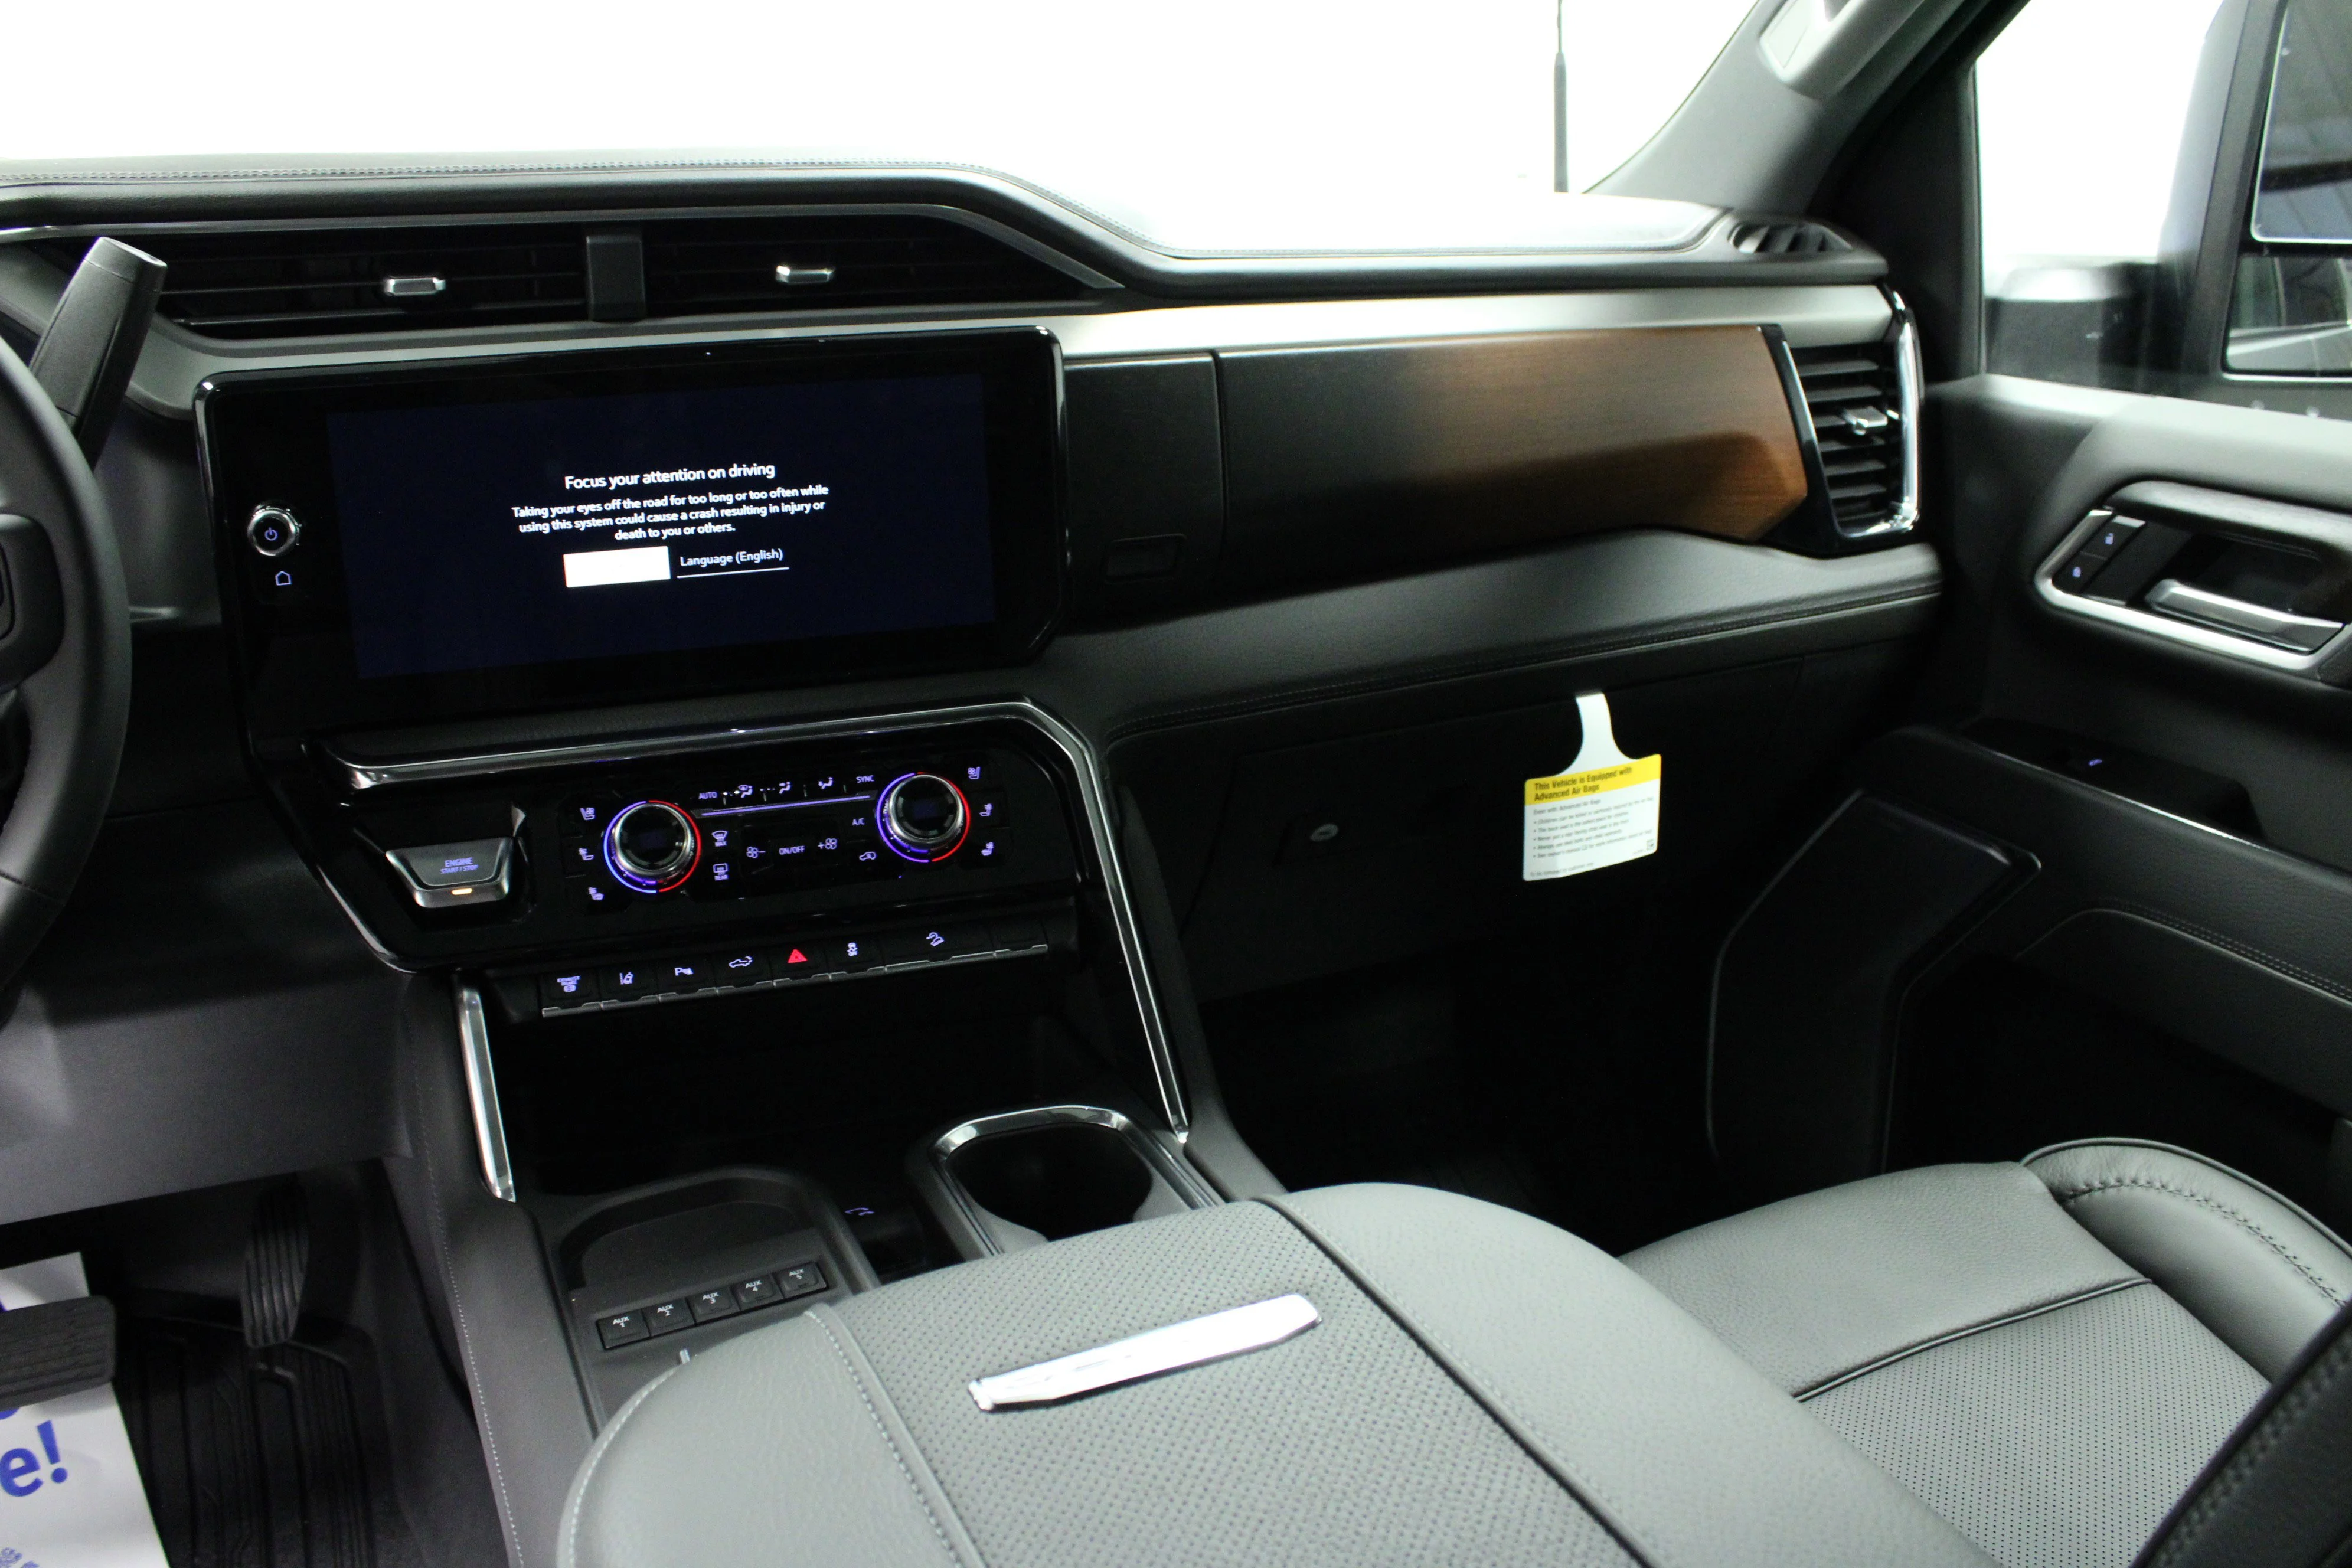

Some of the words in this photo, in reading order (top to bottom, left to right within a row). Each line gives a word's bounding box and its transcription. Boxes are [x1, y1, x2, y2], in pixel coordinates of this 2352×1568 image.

[564, 476, 607, 489] Focus
[609, 474, 641, 490] your
[642, 468, 705, 484] attention
[707, 468, 726, 479] on
[729, 463, 776, 479] driving
[511, 506, 550, 518] Taking
[550, 506, 576, 518] your
[577, 502, 603, 515] eyes
[604, 499, 622, 510] off
[622, 498, 641, 509] the
[643, 495, 668, 508] road
[669, 494, 687, 506] for
[688, 495, 707, 504] too
[708, 492, 734, 504] long
[735, 492, 747, 501] or
[749, 490, 768, 499] too
[769, 486, 799, 499] often
[800, 484, 829, 496] while
[519, 521, 550, 534] using
[551, 518, 573, 530] this
[574, 517, 613, 531] system
[615, 512, 645, 525] could
[646, 512, 678, 522] cause
[689, 507, 718, 519] crash
[720, 505, 767, 517] resulting
[769, 504, 779, 514] in
[781, 502, 812, 515] injury
[812, 502, 825, 510] or
[615, 527, 646, 540] death
[648, 528, 660, 538] to
[661, 528, 682, 540] you
[683, 527, 696, 535] or
[697, 522, 736, 534] others.
[680, 554, 734, 568] Language
[736, 548, 783, 564] (English)
[1553, 778, 1577, 789] Vehicle
[1587, 770, 1618, 783] Equipped
[1619, 767, 1632, 775] with
[1534, 788, 1570, 801] Advanced
[1583, 785, 1599, 793] Bags
[779, 845, 805, 855] ON/OFF
[445, 857, 473, 867] ENGINE
[745, 1280, 762, 1289] AUX
[703, 1292, 719, 1301] AUX
[657, 1304, 674, 1313] AUX
[613, 1316, 629, 1325] AUX
